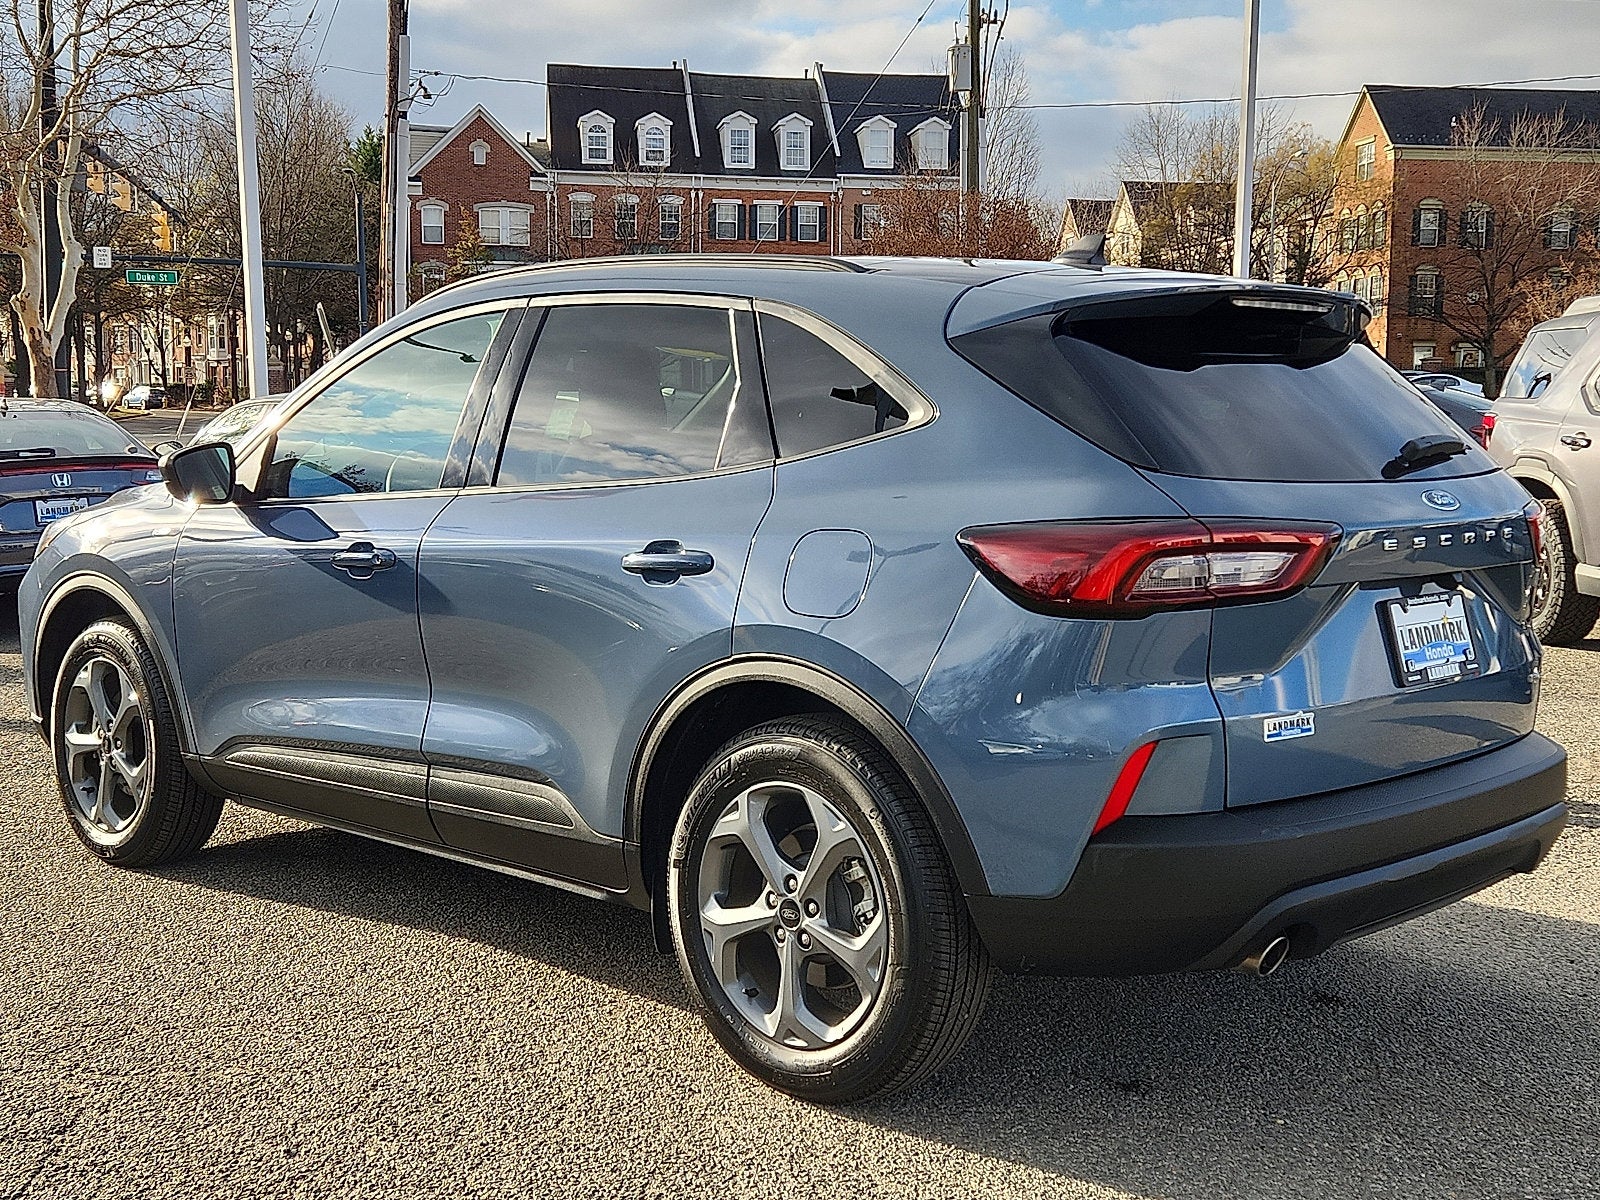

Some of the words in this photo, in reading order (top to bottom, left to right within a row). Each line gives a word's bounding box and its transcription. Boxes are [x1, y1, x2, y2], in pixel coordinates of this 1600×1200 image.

[136, 272, 156, 282] Duke
[158, 273, 168, 282] St
[1383, 527, 1513, 551] ESCAPE
[1399, 619, 1466, 651] LANDMARK
[1424, 643, 1455, 661] Honda
[1427, 662, 1460, 678] LANDMARK
[1267, 717, 1311, 732] LANDMARK
[683, 760, 731, 830] MICHELIN
